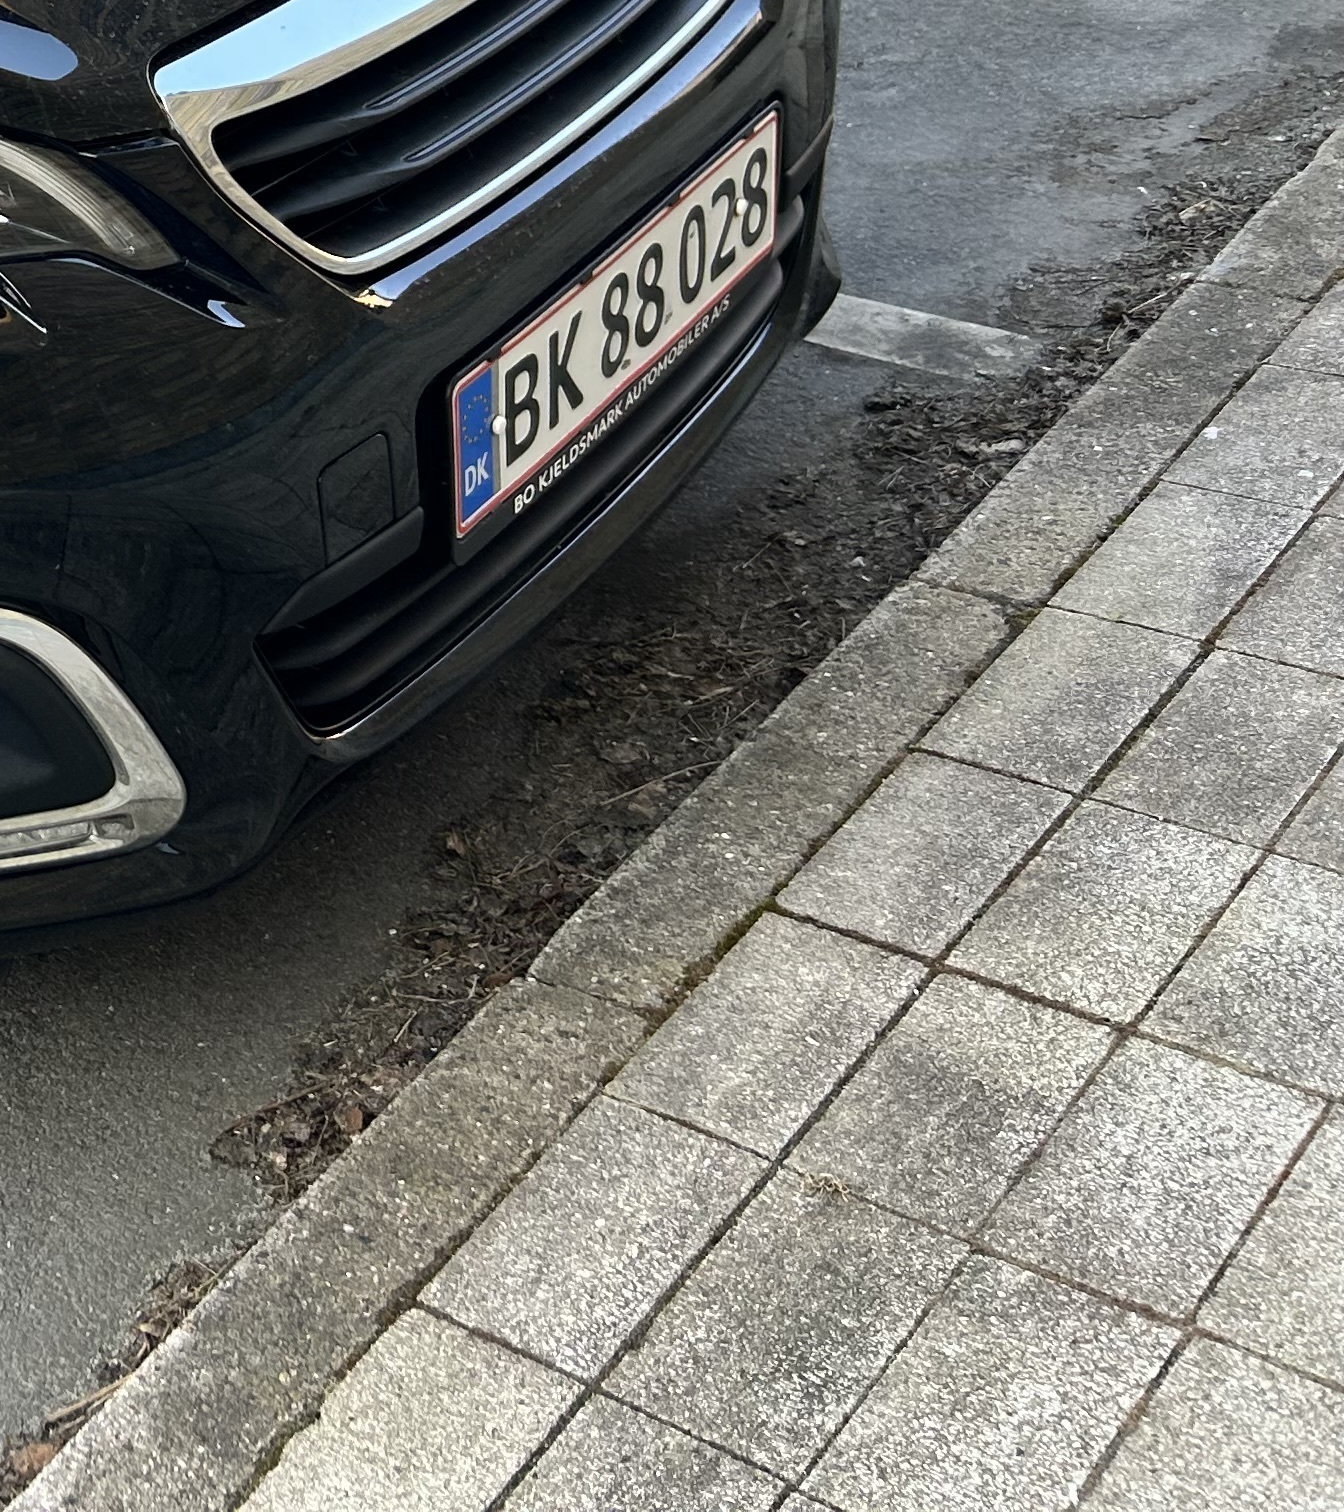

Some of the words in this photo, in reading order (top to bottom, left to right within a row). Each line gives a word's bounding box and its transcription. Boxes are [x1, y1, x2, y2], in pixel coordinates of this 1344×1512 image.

[504, 310, 584, 468] BK
[600, 242, 665, 378] 88
[678, 147, 768, 304] 028
[513, 485, 536, 514] BO
[537, 402, 624, 488] KJELDSMARK
[624, 314, 710, 405] AUTOMOBILER
[710, 293, 731, 325] A/S
[464, 451, 490, 497] DK
